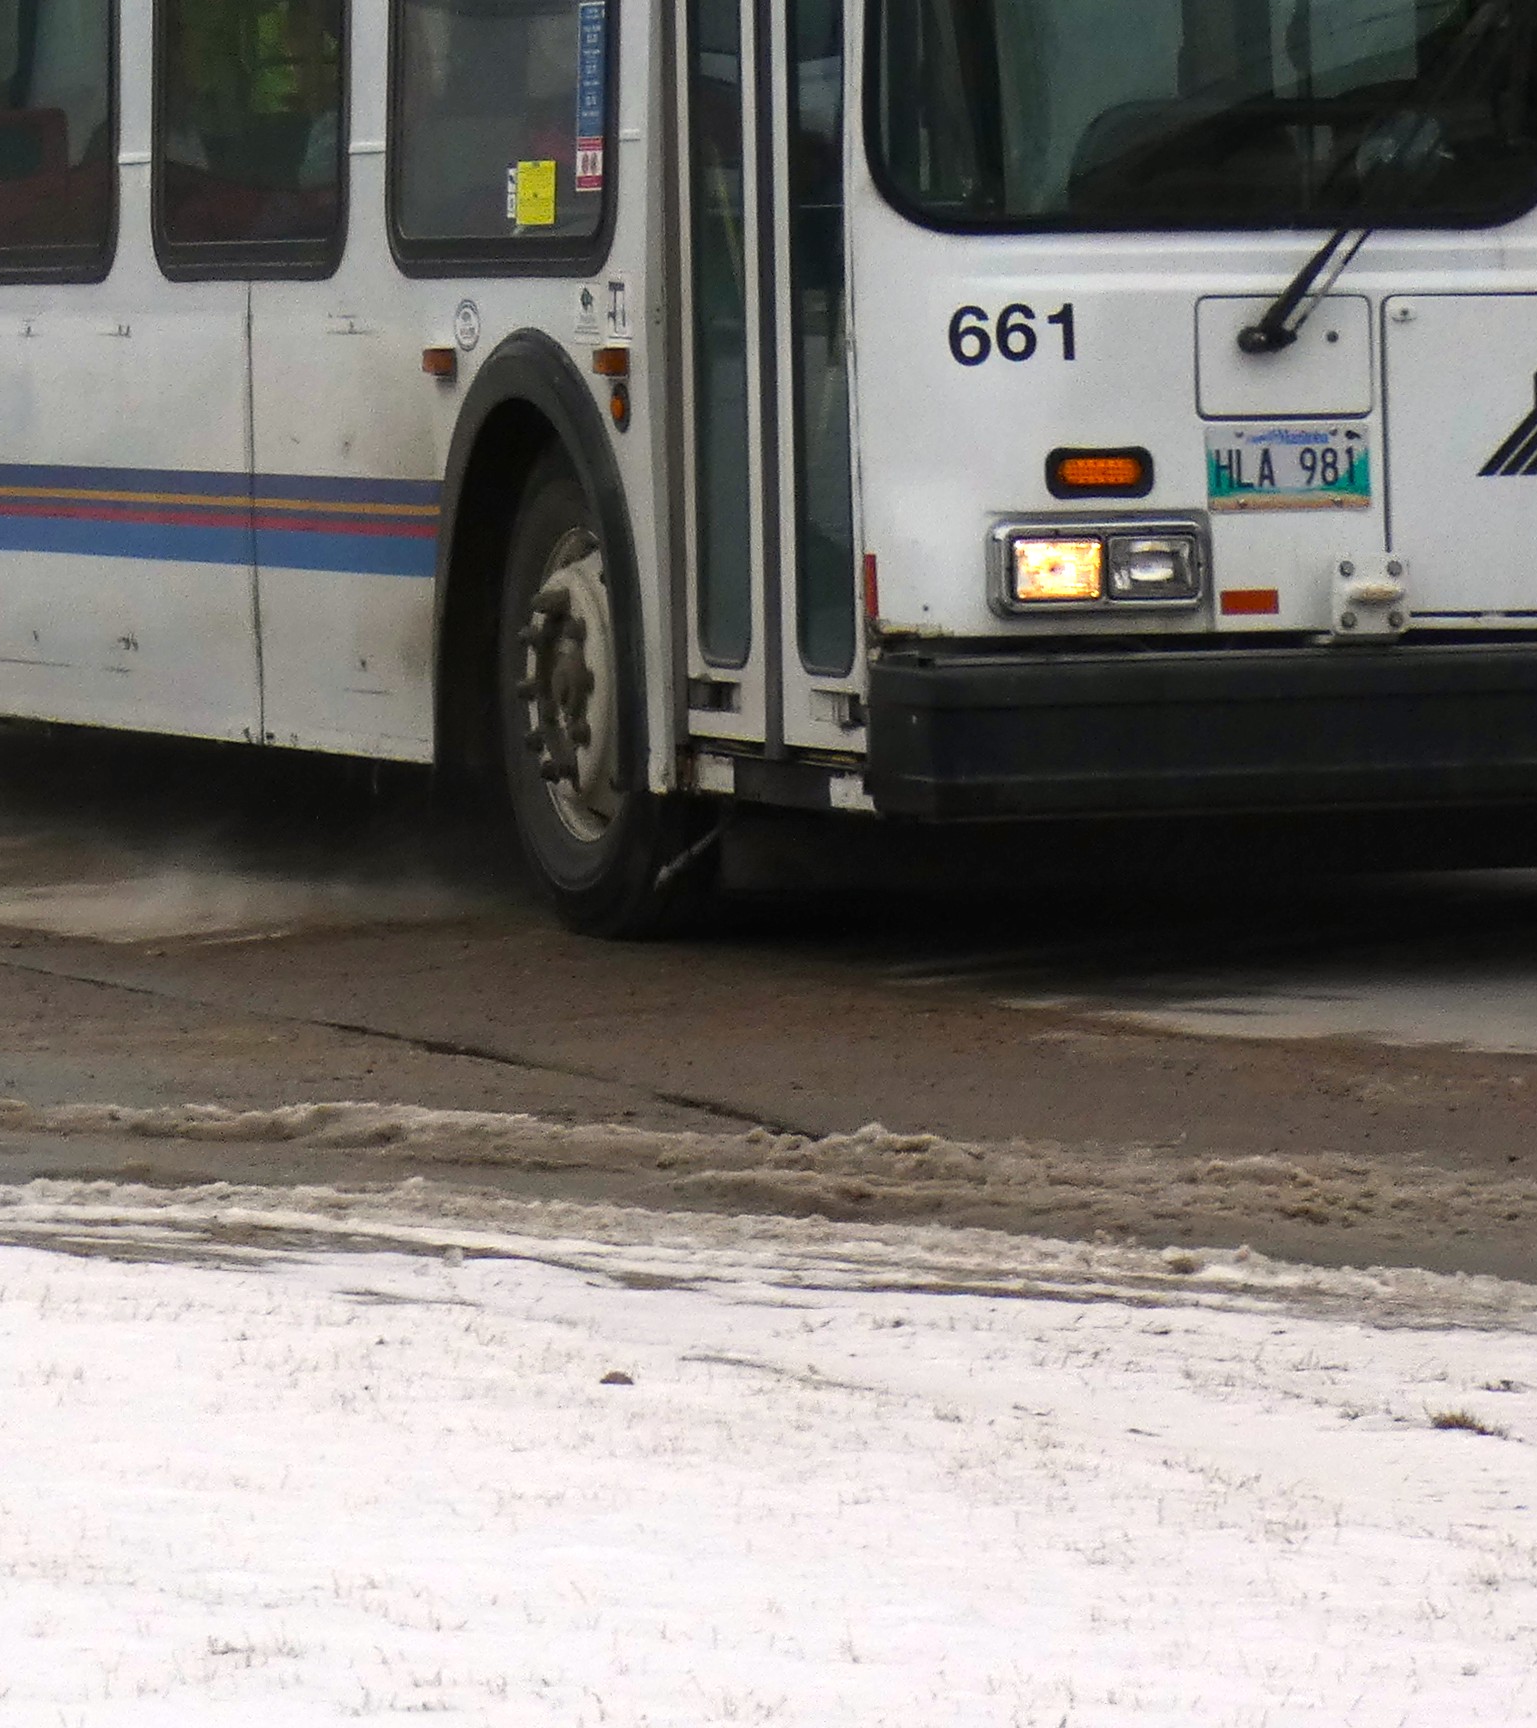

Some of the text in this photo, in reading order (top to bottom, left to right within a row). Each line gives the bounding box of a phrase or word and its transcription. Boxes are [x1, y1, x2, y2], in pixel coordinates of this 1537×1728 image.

[948, 302, 1076, 367] 661
[1215, 446, 1355, 489] HLA 981
